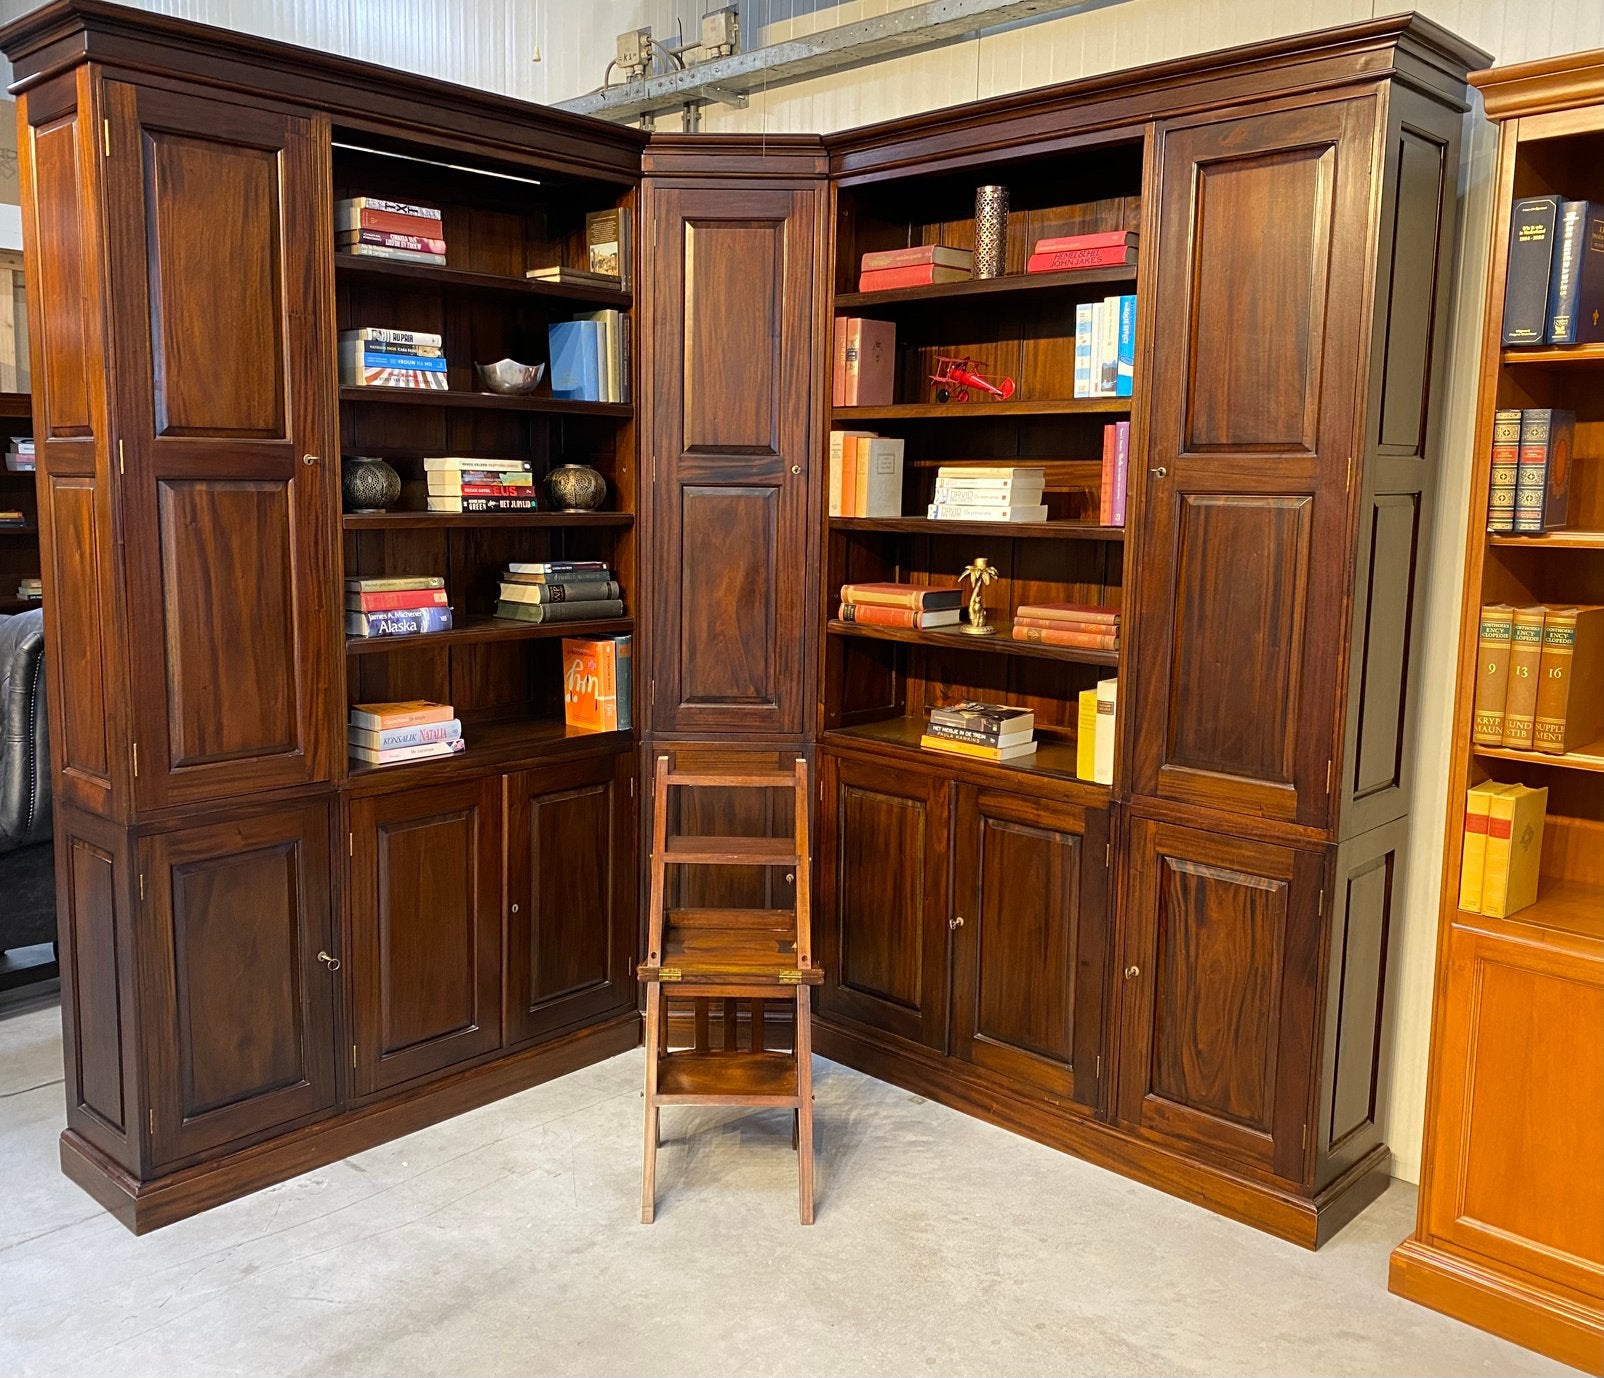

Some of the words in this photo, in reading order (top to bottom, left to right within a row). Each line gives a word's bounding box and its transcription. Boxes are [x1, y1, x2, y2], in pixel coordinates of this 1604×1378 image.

[1050, 260, 1074, 268] JOHN
[1074, 256, 1102, 265] JAKES
[492, 486, 518, 497] EUS
[368, 613, 388, 622] James
[378, 620, 417, 634] Alaska
[1488, 663, 1496, 675] 9
[1516, 666, 1528, 678] 13
[1548, 667, 1562, 679] 16
[1477, 717, 1501, 725] KRYP
[1506, 719, 1532, 729] RUND
[1474, 725, 1503, 734] MAUN
[1506, 729, 1527, 737] STIB
[1535, 722, 1565, 733] SUPPLE
[383, 733, 418, 746] KONSALIK
[419, 727, 447, 741] NATALIA
[1536, 732, 1564, 741] MENT
